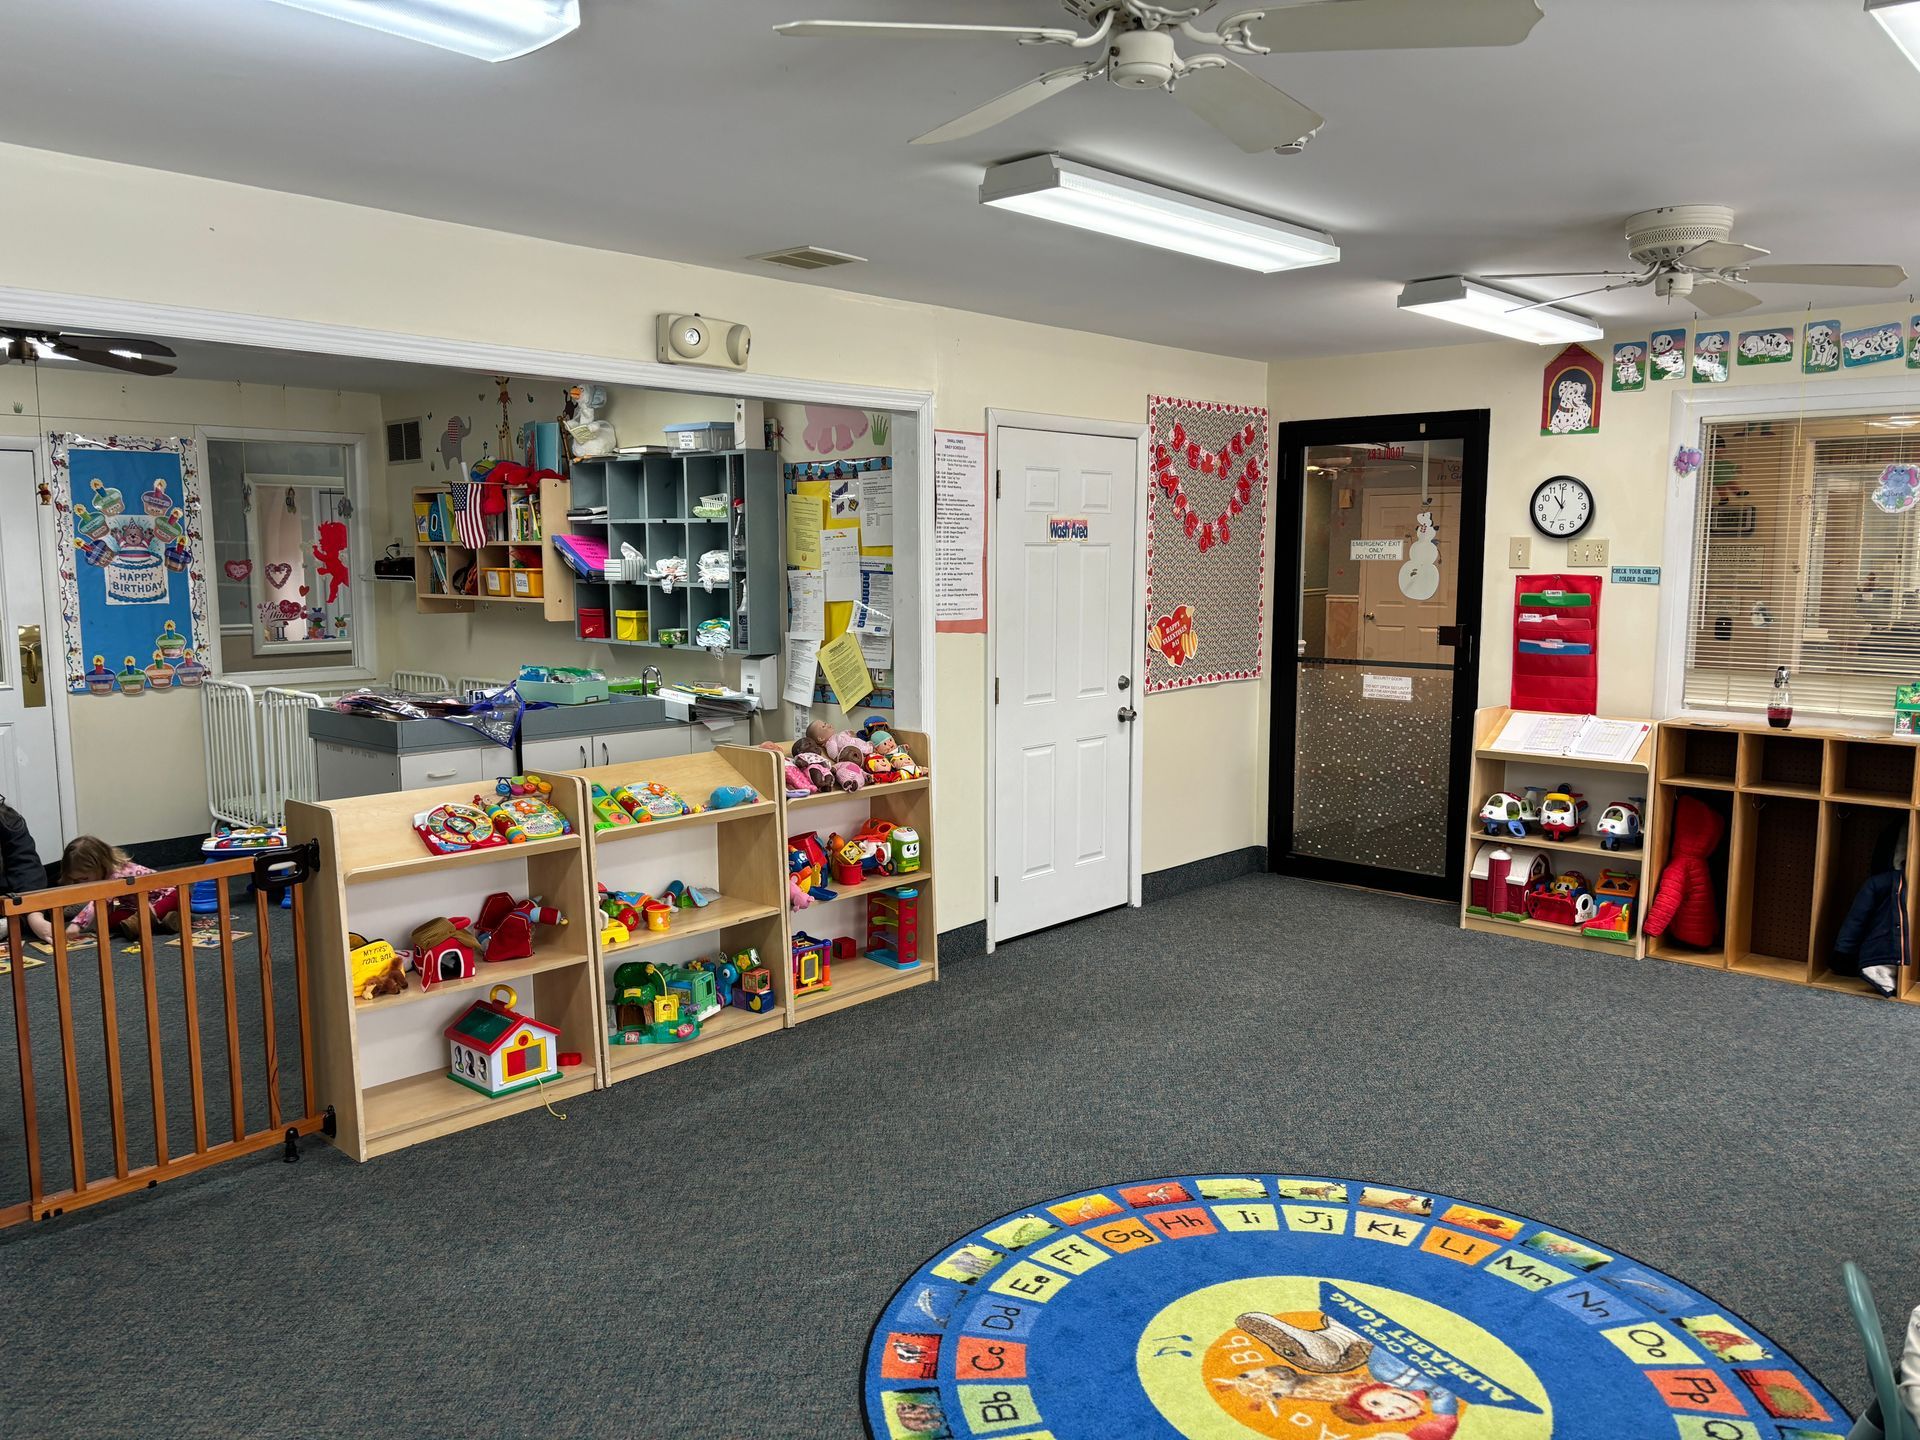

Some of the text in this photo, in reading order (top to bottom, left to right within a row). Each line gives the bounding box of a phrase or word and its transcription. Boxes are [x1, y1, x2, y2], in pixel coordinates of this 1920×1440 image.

[1766, 339, 1773, 347] 4
[1820, 345, 1826, 353] 5
[1865, 340, 1871, 348] 6
[1673, 356, 1679, 364] 2
[1708, 354, 1713, 362] 3
[1549, 486, 1556, 494] 11
[1558, 482, 1567, 491] 12
[1571, 485, 1575, 493] 1
[1541, 494, 1550, 502] 10
[1577, 492, 1584, 500] 2
[1538, 503, 1544, 511] 9
[1580, 502, 1587, 510] 3
[1541, 513, 1547, 521] 8
[1577, 513, 1583, 521] 4
[1050, 521, 1088, 538] Wash Area
[1549, 520, 1555, 528] 7
[1558, 523, 1565, 531] 6
[1569, 520, 1575, 528] 5
[119, 572, 154, 581] HAPPY
[112, 581, 163, 593] BIRTHDAY
[1165, 619, 1181, 635] HAPPY
[1171, 638, 1180, 649] DAY
[362, 952, 393, 965] TOOL BOX
[363, 949, 372, 957] MY
[1158, 1213, 1205, 1231] Hh
[1237, 1209, 1261, 1225] Ii
[1298, 1210, 1335, 1232] Jj
[1367, 1219, 1408, 1240] Kk
[1101, 1228, 1156, 1245] Gg
[1439, 1236, 1476, 1256] Ll
[1050, 1242, 1091, 1266] Ff
[1494, 1255, 1554, 1288] Mm
[1009, 1274, 1051, 1295] Ee
[1566, 1290, 1611, 1320] Nn
[981, 1303, 1021, 1332] Dd
[1329, 1291, 1517, 1402] ALPHABET SONG
[1627, 1328, 1668, 1359] Oo
[1220, 1334, 1266, 1366] Bb
[1363, 1325, 1449, 1378] Zoo Crew
[970, 1345, 1006, 1373] Cc
[1669, 1376, 1719, 1406] Pp
[978, 1390, 1020, 1424] Bb
